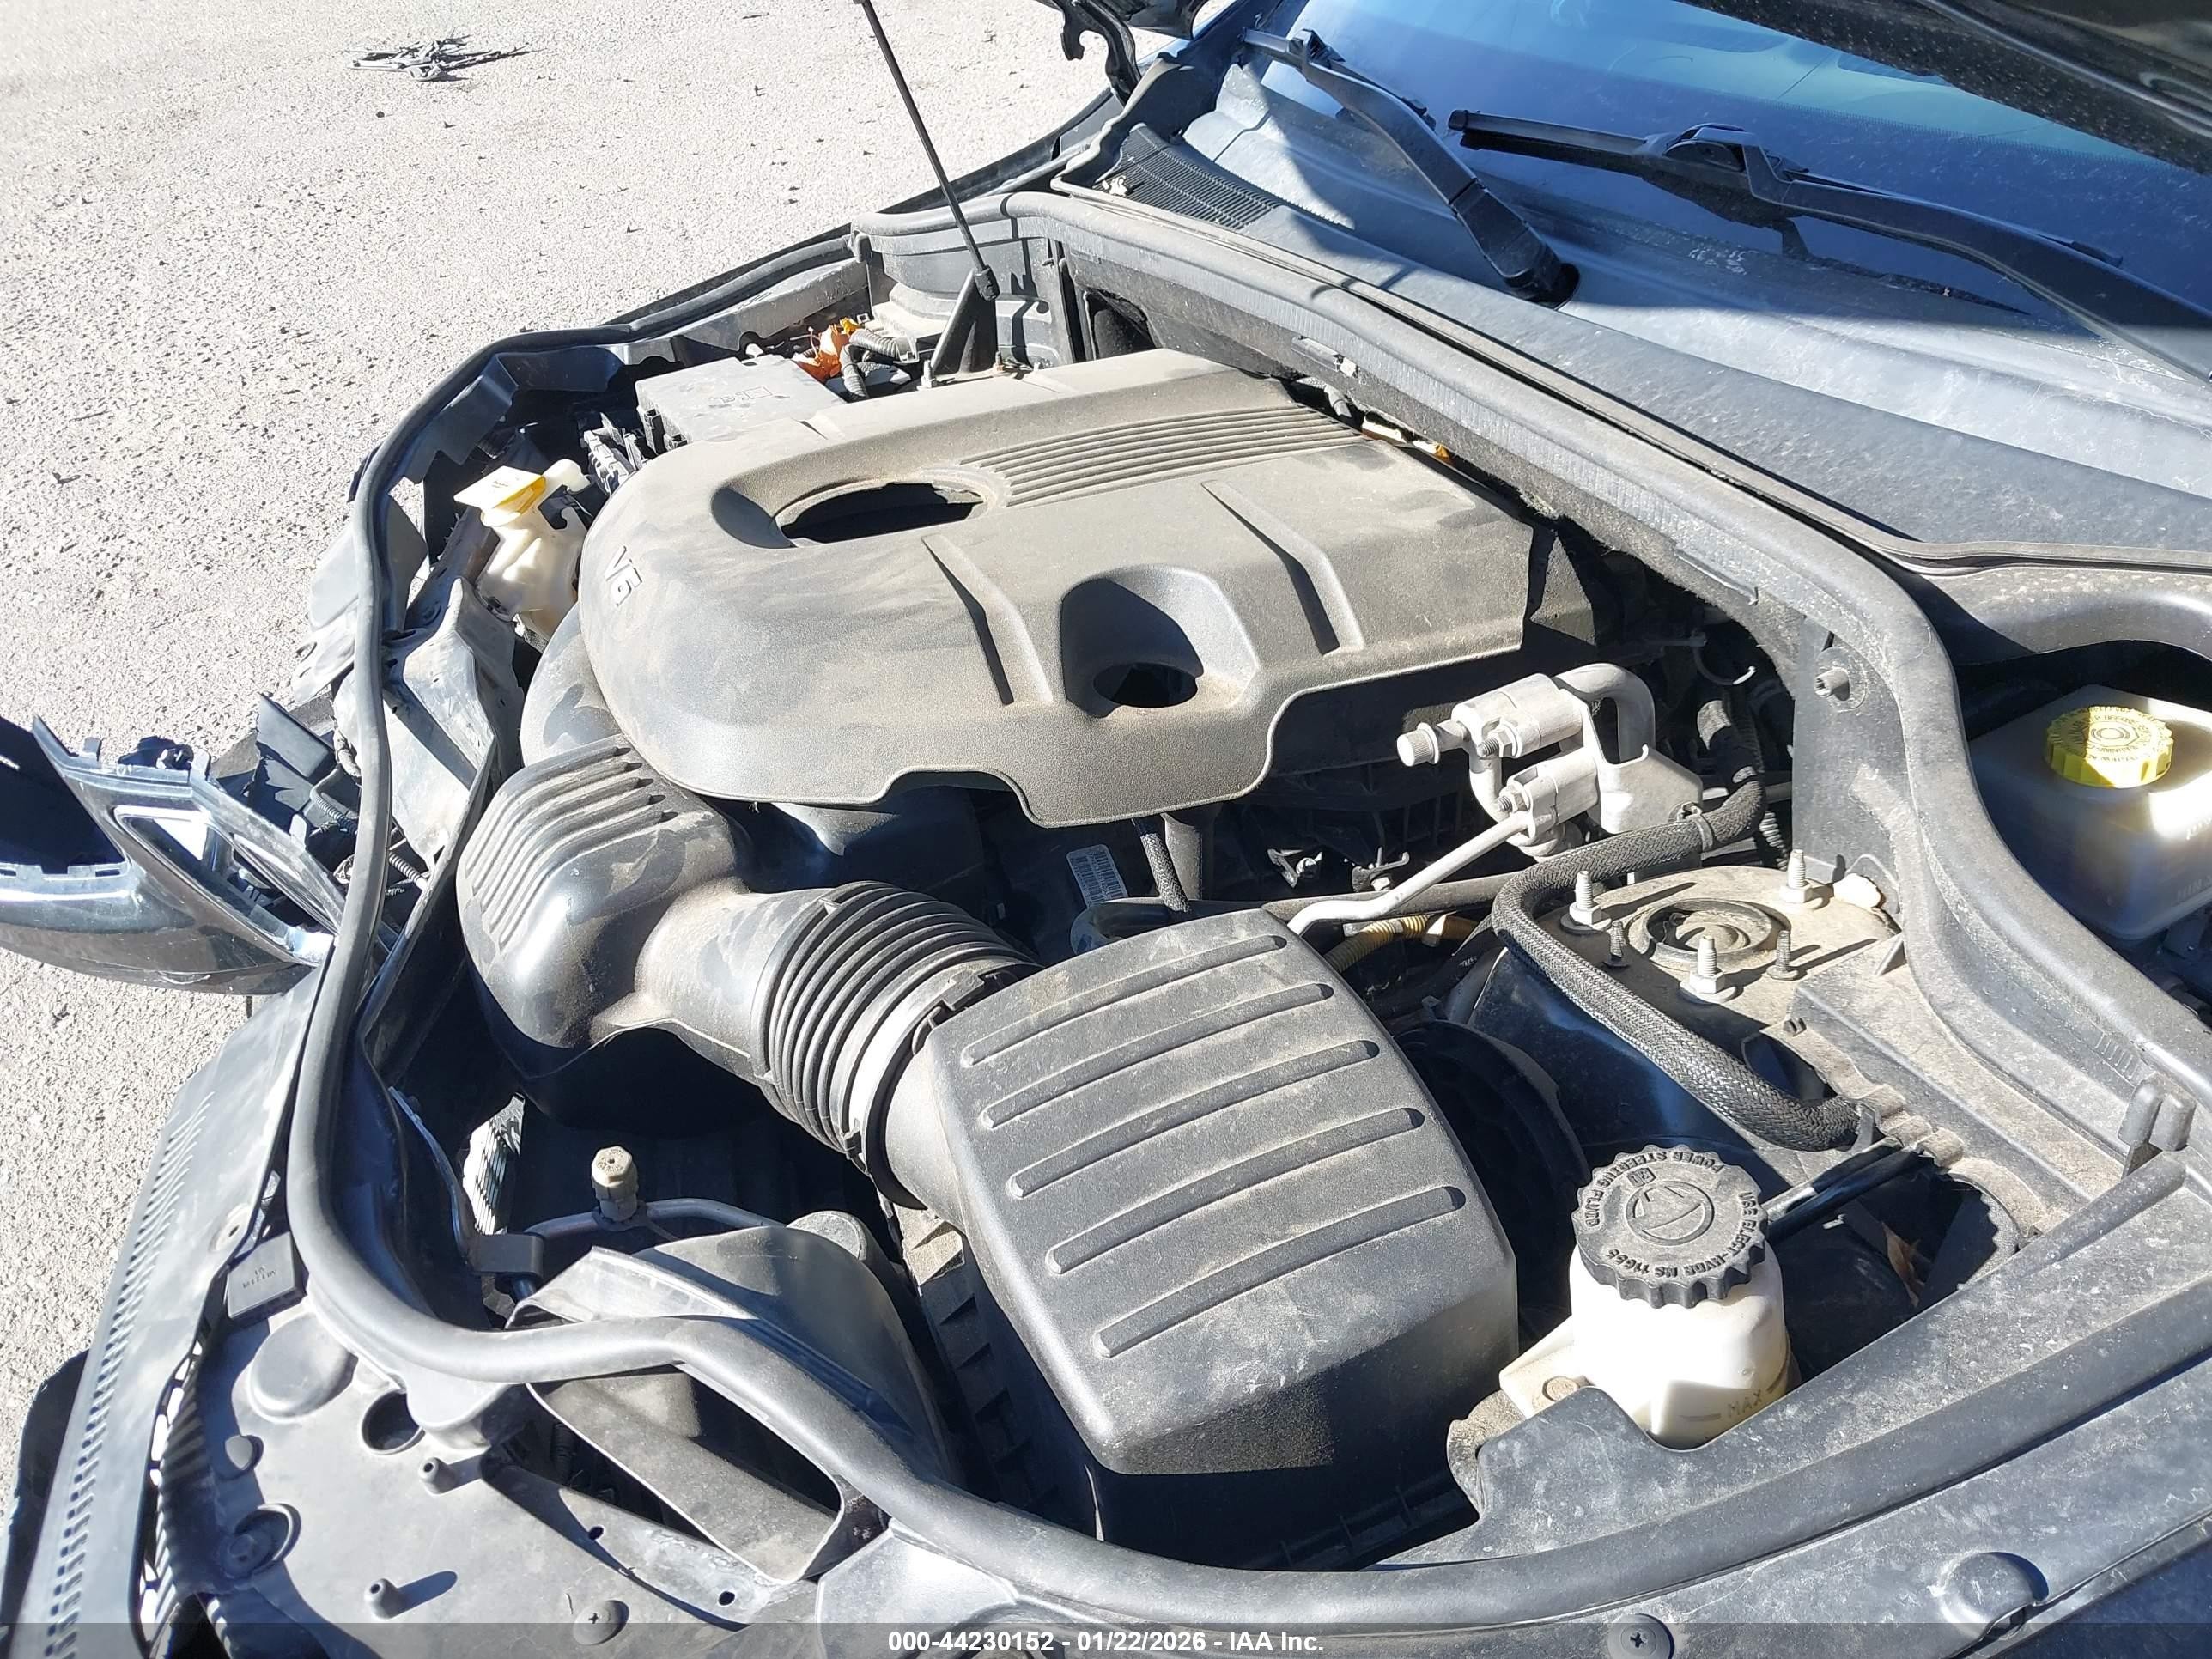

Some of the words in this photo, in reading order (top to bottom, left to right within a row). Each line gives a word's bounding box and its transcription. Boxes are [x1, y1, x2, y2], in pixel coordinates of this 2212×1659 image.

[604, 543, 642, 609] V6
[1598, 1151, 1667, 1188] STEERING
[1672, 1151, 1726, 1174] POWER
[1584, 1188, 1605, 1228] FLUID
[1737, 1191, 1759, 1217] USE
[1654, 1266, 1680, 1278] MS
[1726, 1388, 1763, 1419] MAX
